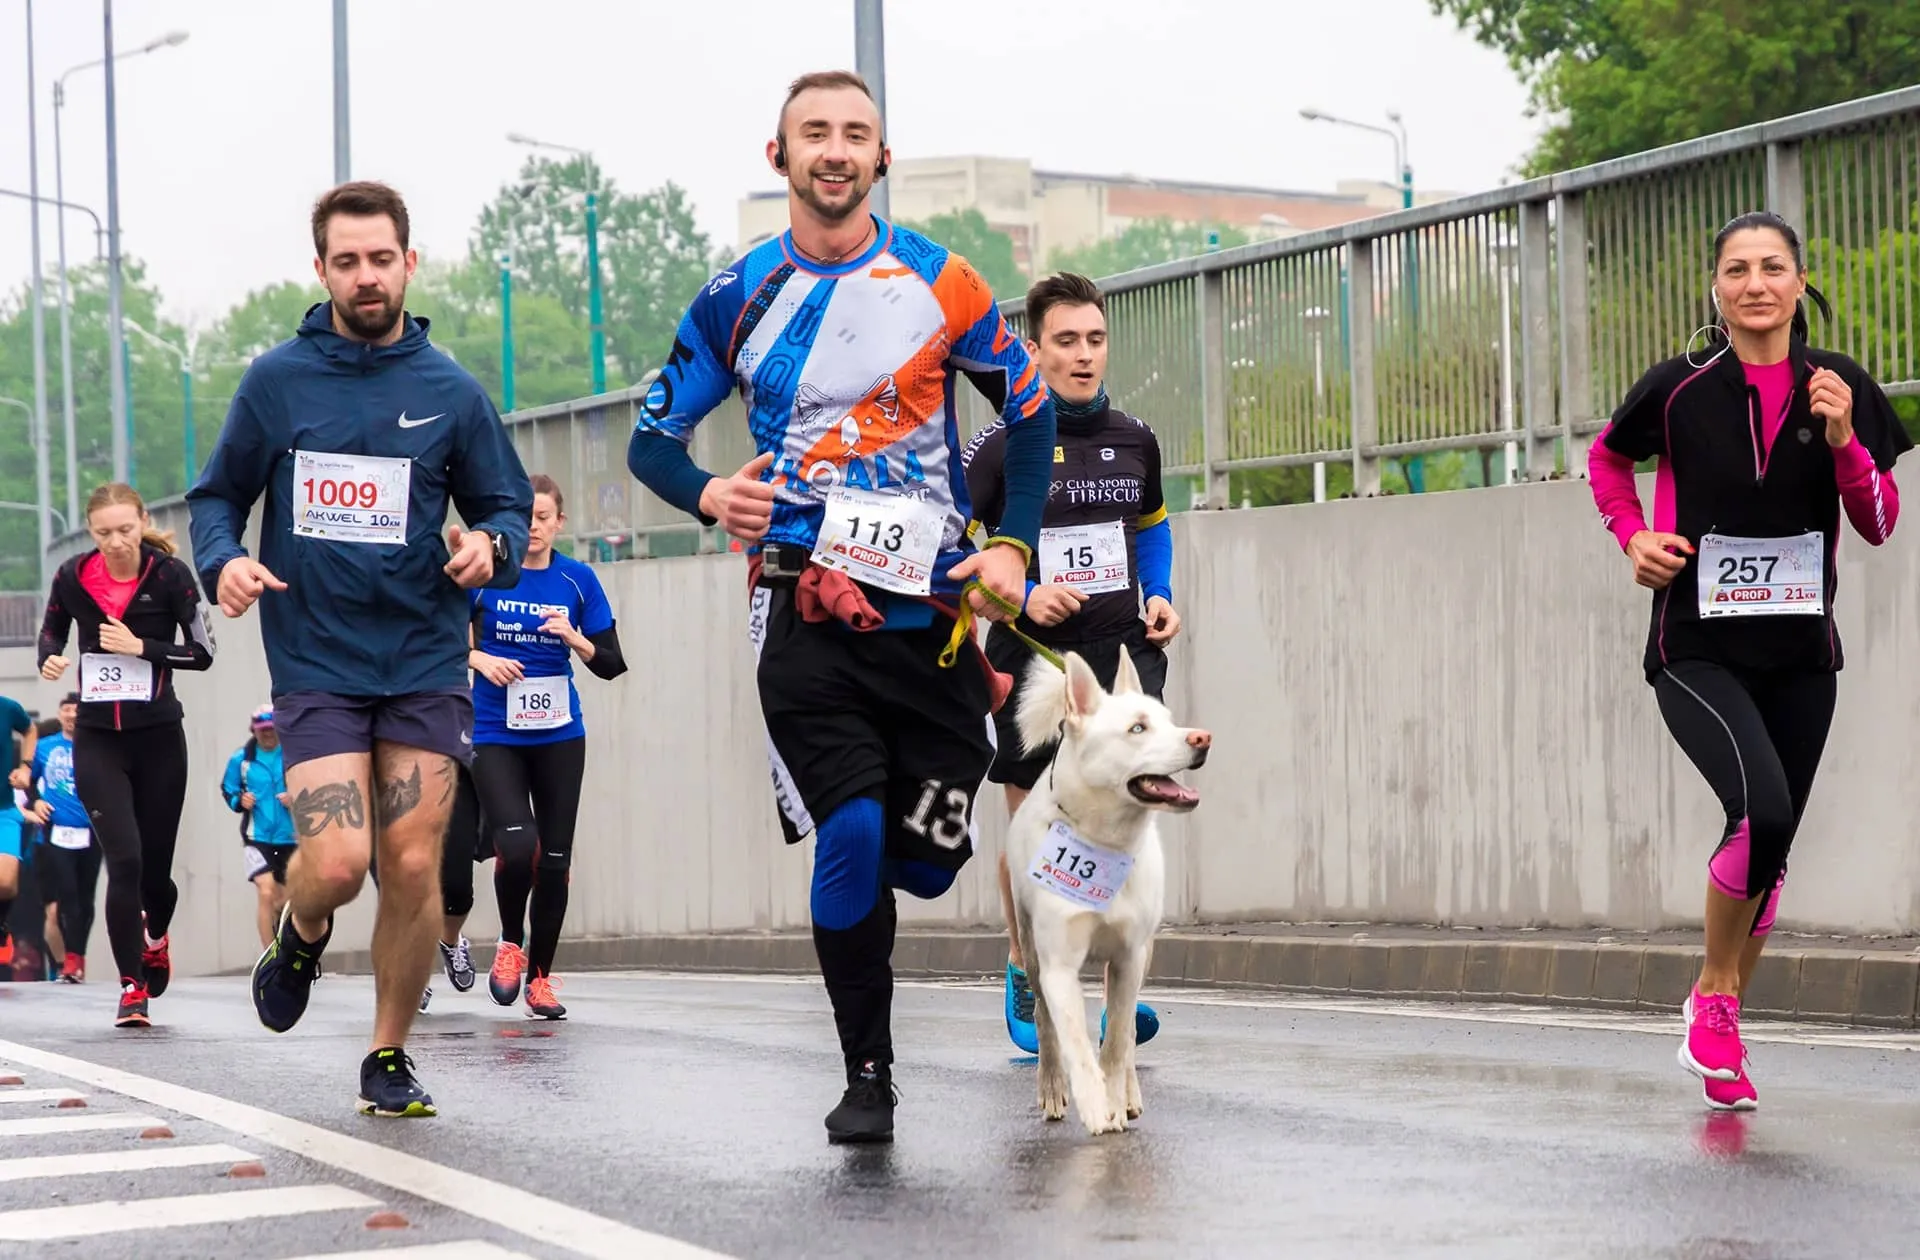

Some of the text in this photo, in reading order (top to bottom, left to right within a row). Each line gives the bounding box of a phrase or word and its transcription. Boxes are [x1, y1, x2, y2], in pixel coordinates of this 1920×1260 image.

[782, 449, 926, 494] KOALA
[1066, 479, 1139, 489] CLUB SPORTIV
[303, 478, 378, 508] 1009
[1067, 488, 1140, 503] TIBISCUS
[306, 510, 362, 523] AKWEL
[847, 516, 905, 552] 113
[852, 547, 886, 569] PROFI
[1063, 546, 1093, 568] 15
[1067, 572, 1094, 581] PROFI
[1718, 556, 1779, 584] 257
[1734, 590, 1768, 600] PROFI
[496, 599, 528, 614] NTT
[496, 632, 512, 641] NTT
[515, 634, 537, 643] DATA
[99, 667, 121, 681] 33
[519, 693, 551, 709] 186
[902, 779, 968, 850] 13
[1056, 846, 1097, 879] 113
